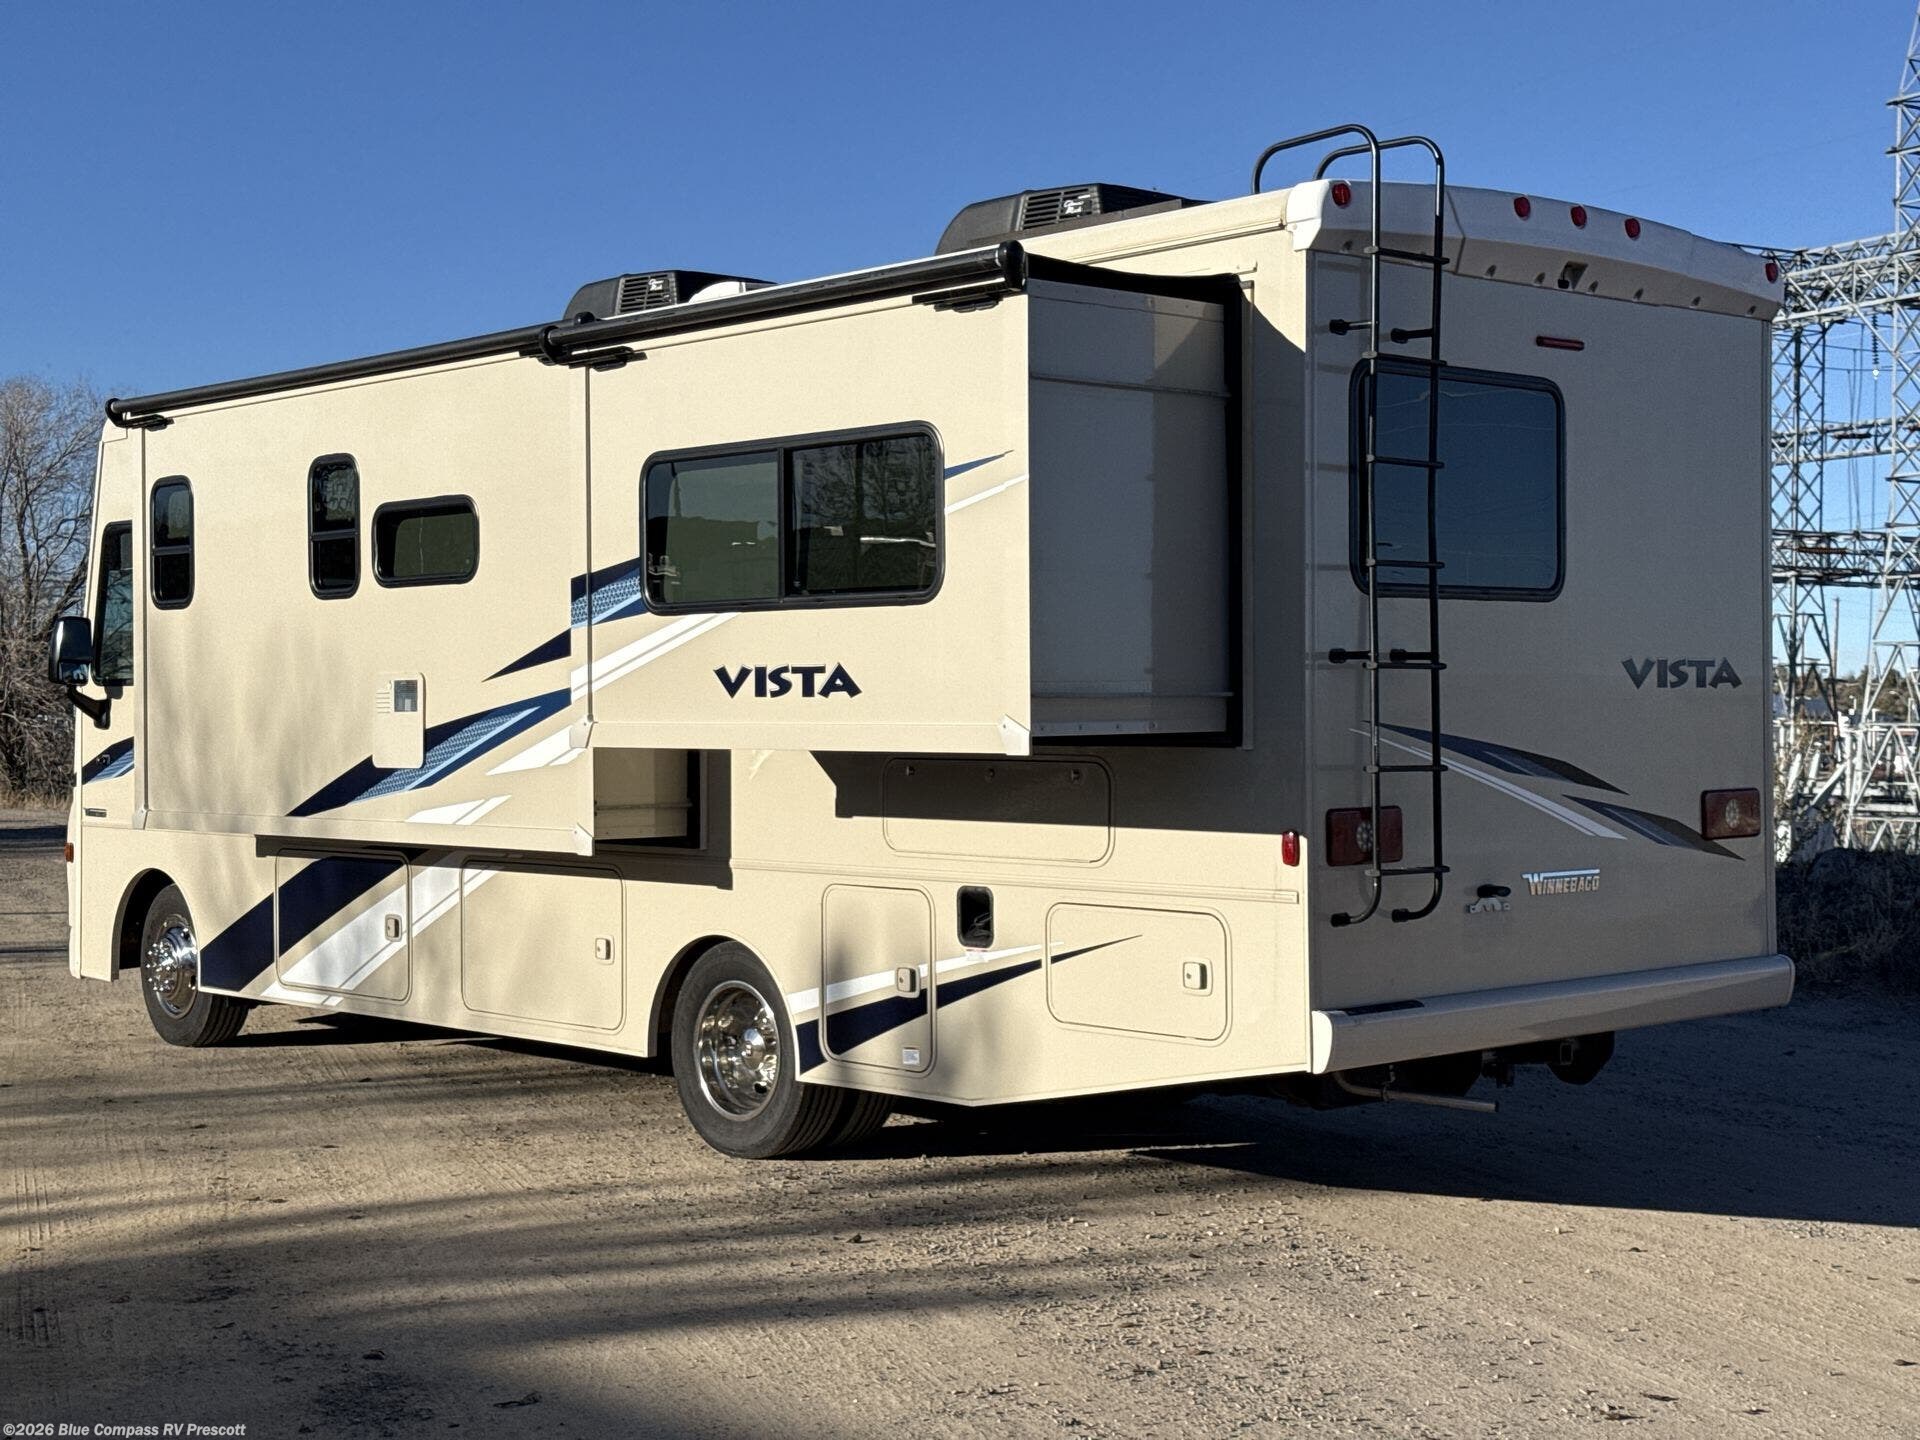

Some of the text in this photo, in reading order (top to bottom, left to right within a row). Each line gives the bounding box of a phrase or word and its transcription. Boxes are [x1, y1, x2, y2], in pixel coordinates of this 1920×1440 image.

[712, 661, 863, 699] VISTA
[1621, 656, 1743, 690] VISTA
[1521, 868, 1600, 896] WINNEBAGO
